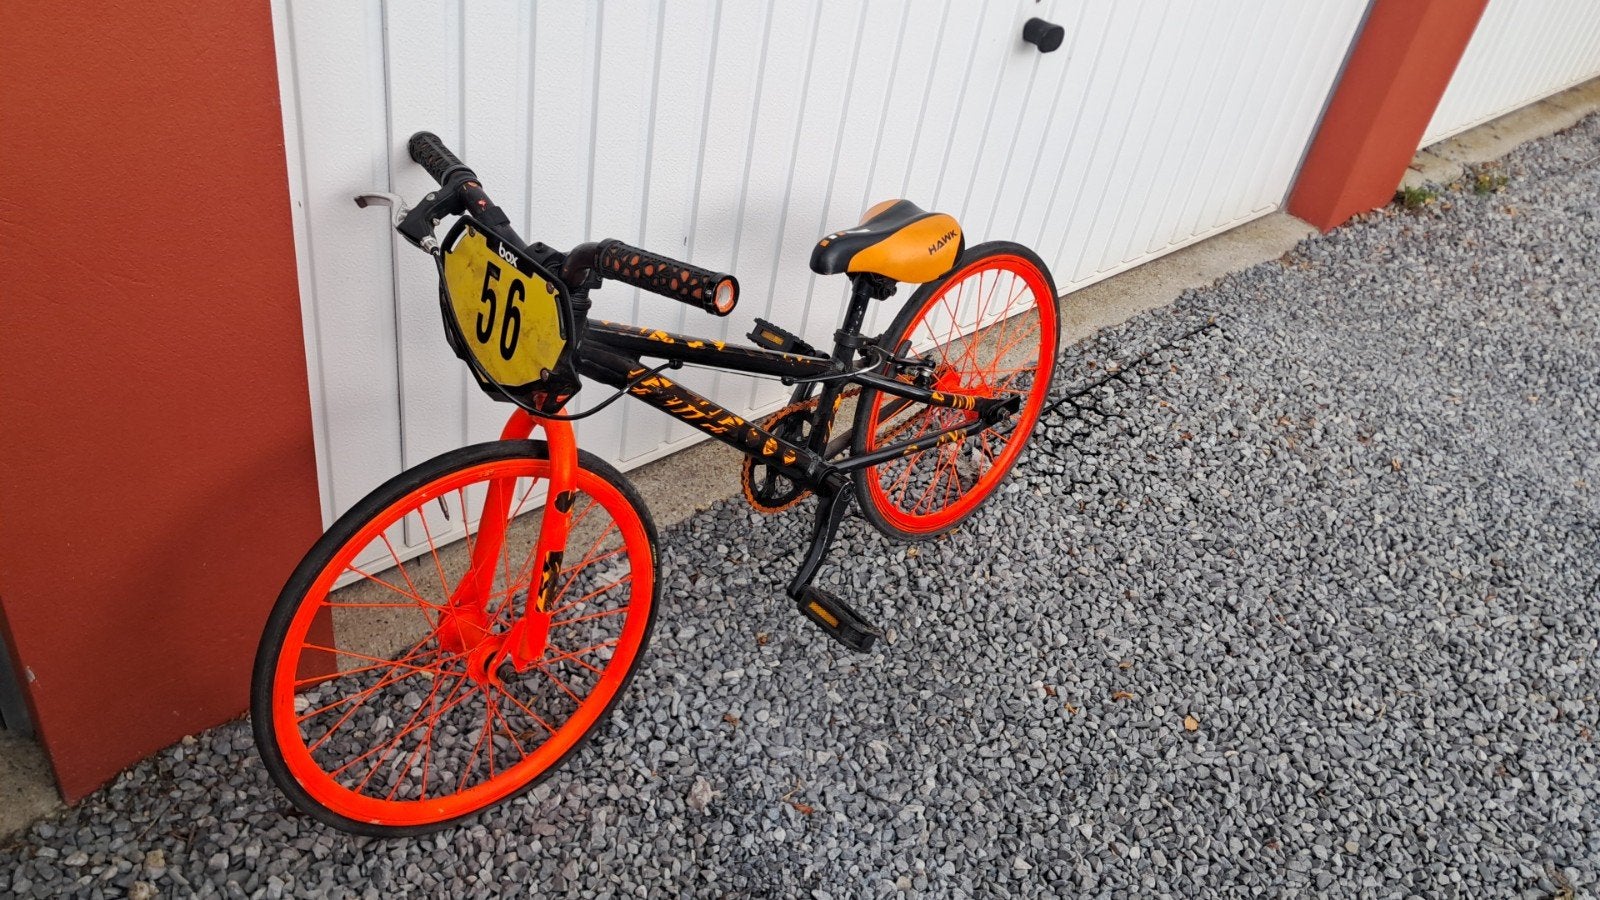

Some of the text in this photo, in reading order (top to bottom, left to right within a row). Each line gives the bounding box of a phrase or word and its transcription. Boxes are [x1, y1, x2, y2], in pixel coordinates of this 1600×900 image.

[499, 241, 518, 268] box
[928, 229, 958, 255] HAWK
[476, 260, 525, 361] 56
